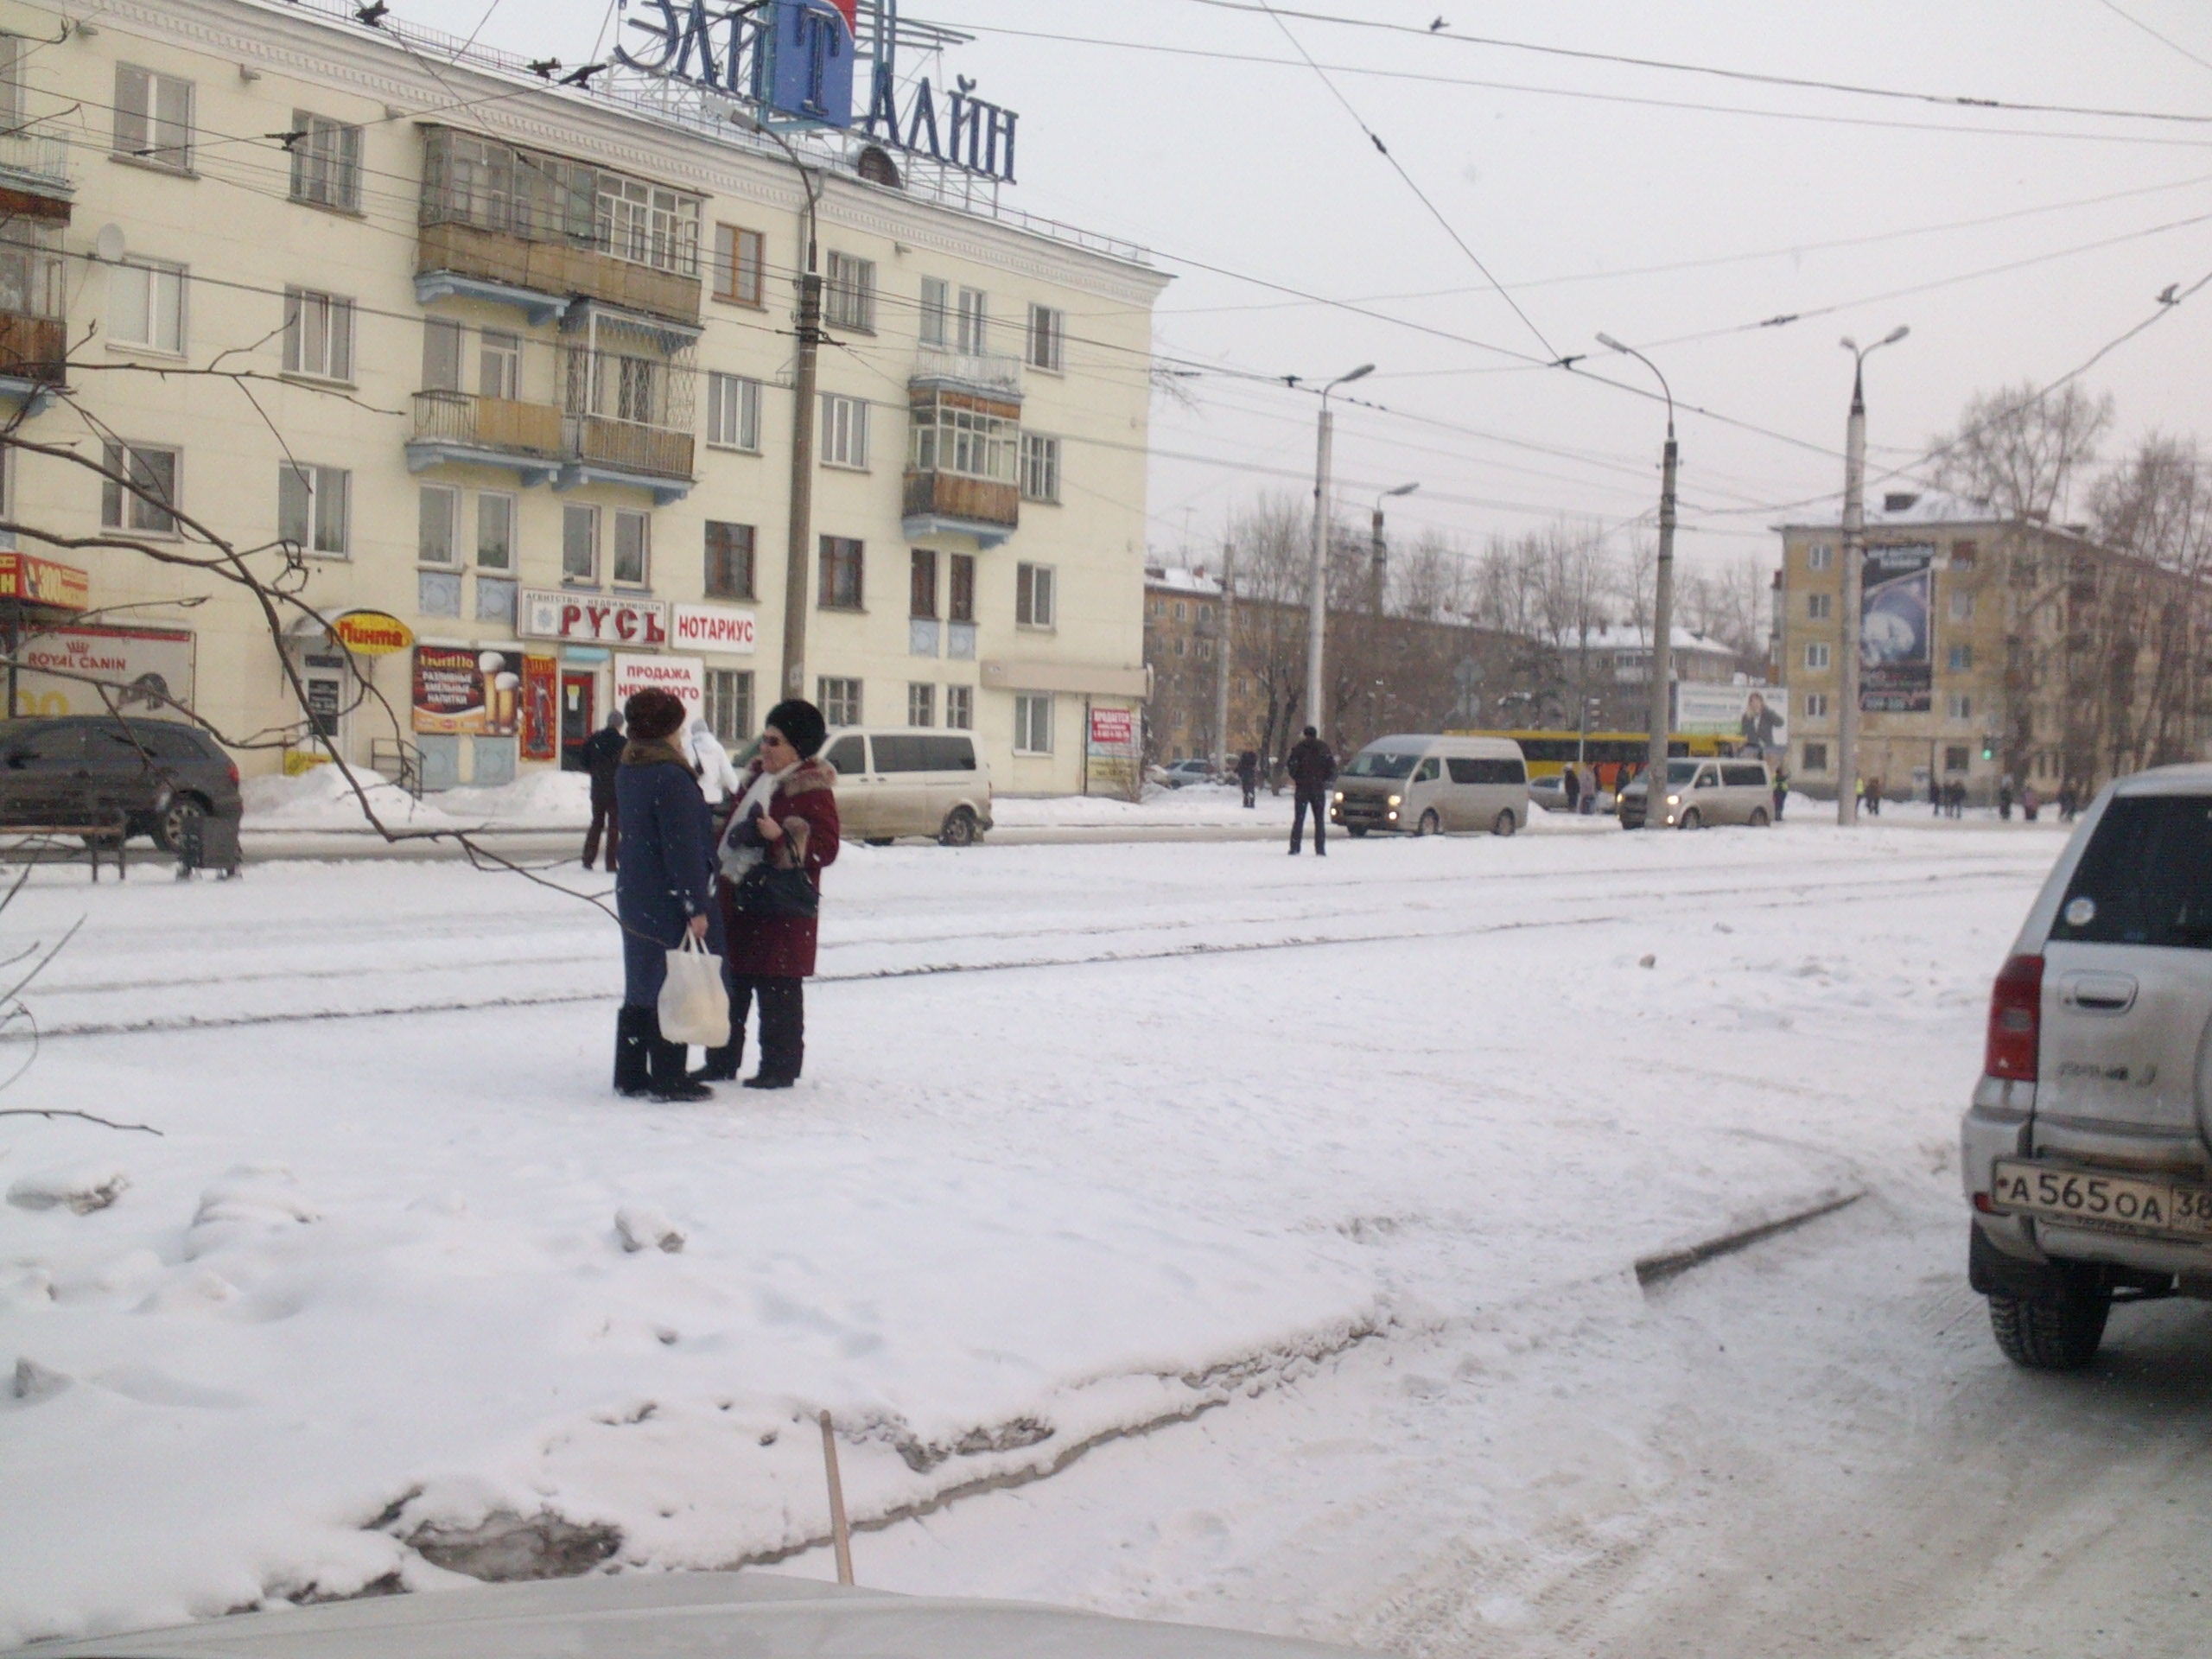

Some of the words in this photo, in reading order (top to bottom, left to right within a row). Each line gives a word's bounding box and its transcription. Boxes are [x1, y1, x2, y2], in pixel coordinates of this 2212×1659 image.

[525, 593, 580, 605] АГЕНТСТВО
[588, 599, 662, 612] НЕДВИЖИМОСТИ
[560, 604, 664, 643] РУСЬ
[678, 614, 754, 643] НОТАРИУС
[28, 652, 74, 669] ROYAL
[79, 657, 127, 671] CANIN
[626, 664, 692, 683] ПРОДАЖА
[2009, 1173, 2164, 1224] А565ОА
